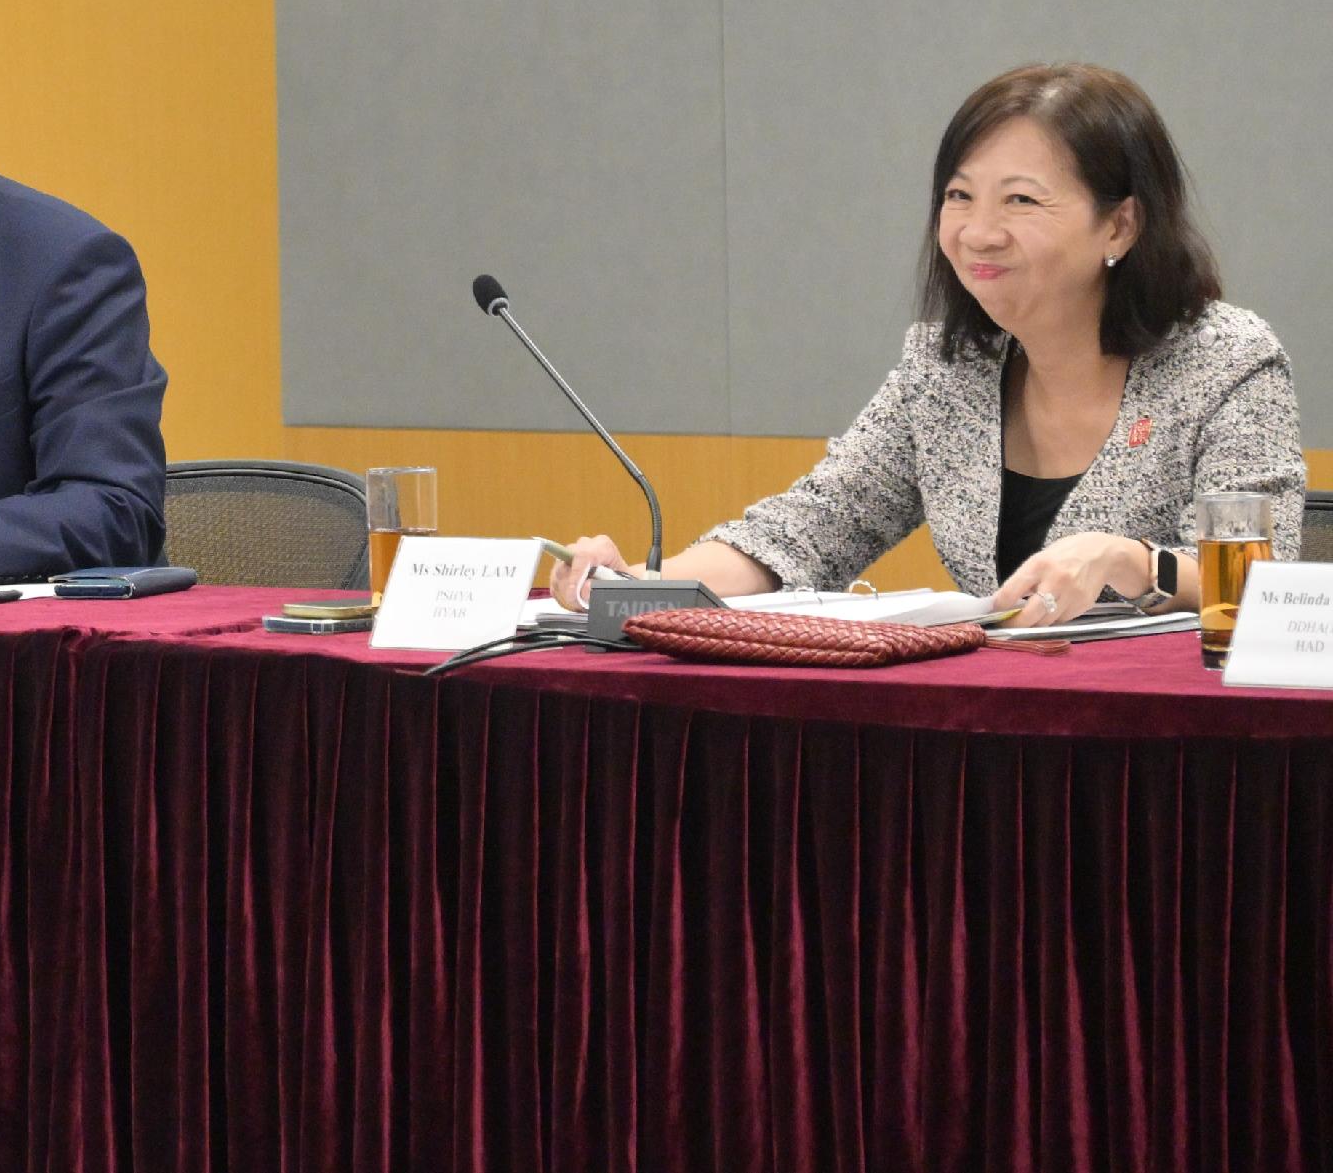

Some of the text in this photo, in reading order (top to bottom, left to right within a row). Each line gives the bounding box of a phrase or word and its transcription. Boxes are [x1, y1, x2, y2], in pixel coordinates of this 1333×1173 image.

[410, 563, 517, 580] Ms Shirley LAM
[1260, 591, 1331, 606] Ms Belinda
[1295, 639, 1325, 653] HAD
